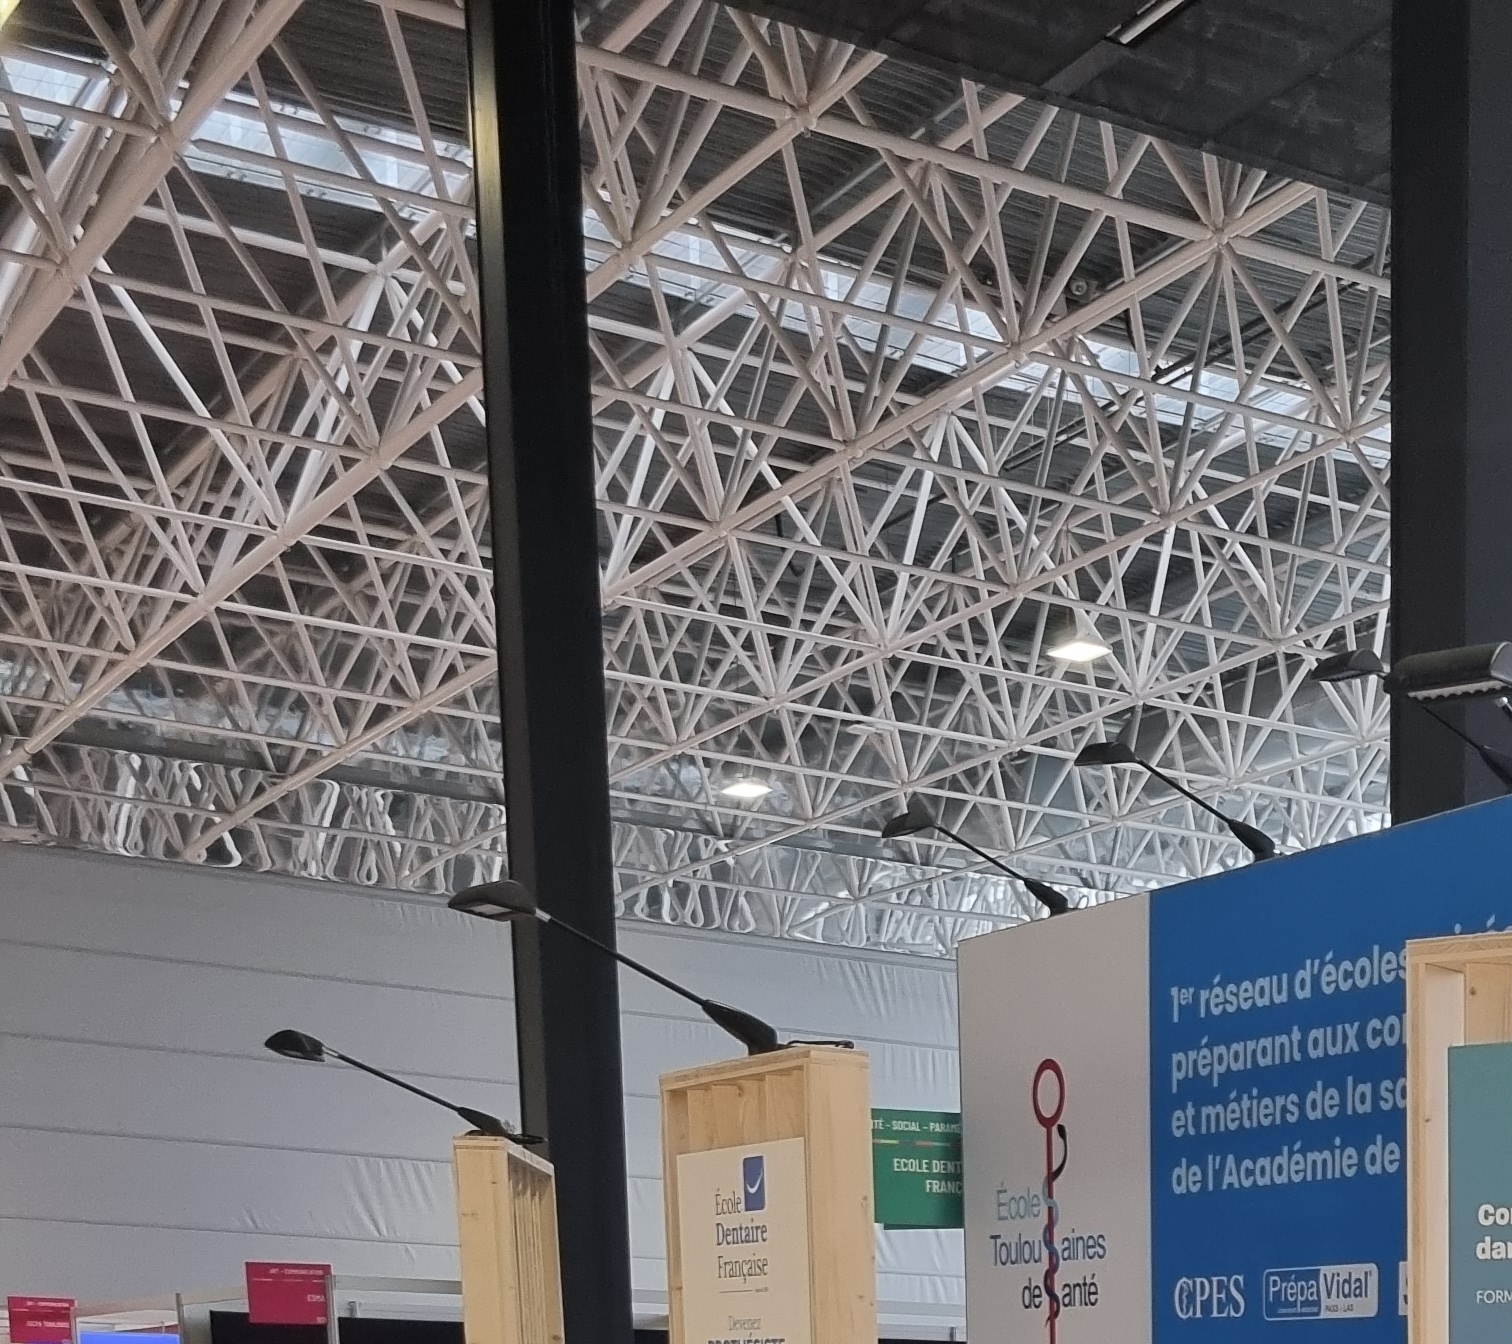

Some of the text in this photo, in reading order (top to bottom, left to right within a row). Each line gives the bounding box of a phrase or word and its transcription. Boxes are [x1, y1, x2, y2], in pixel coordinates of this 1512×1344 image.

[1200, 974, 1288, 1018] réseau
[1171, 1021, 1360, 1093] préparant aux
[1171, 1101, 1195, 1138] et
[1201, 1088, 1299, 1136] métiers
[1306, 1080, 1340, 1121] de
[1347, 1075, 1372, 1115] la
[892, 1120, 921, 1132] SOCIAL
[893, 1158, 930, 1173] ECOLE
[1172, 1134, 1400, 1195] de l'Académie de
[715, 1188, 742, 1216] École
[996, 1182, 1041, 1221] École
[716, 1218, 768, 1246] Dentaire
[717, 1253, 768, 1284] Française
[1022, 1277, 1043, 1309] de
[1174, 1274, 1245, 1320] CPES
[1268, 1273, 1318, 1313] Prépa
[728, 1315, 761, 1331] Devenez
